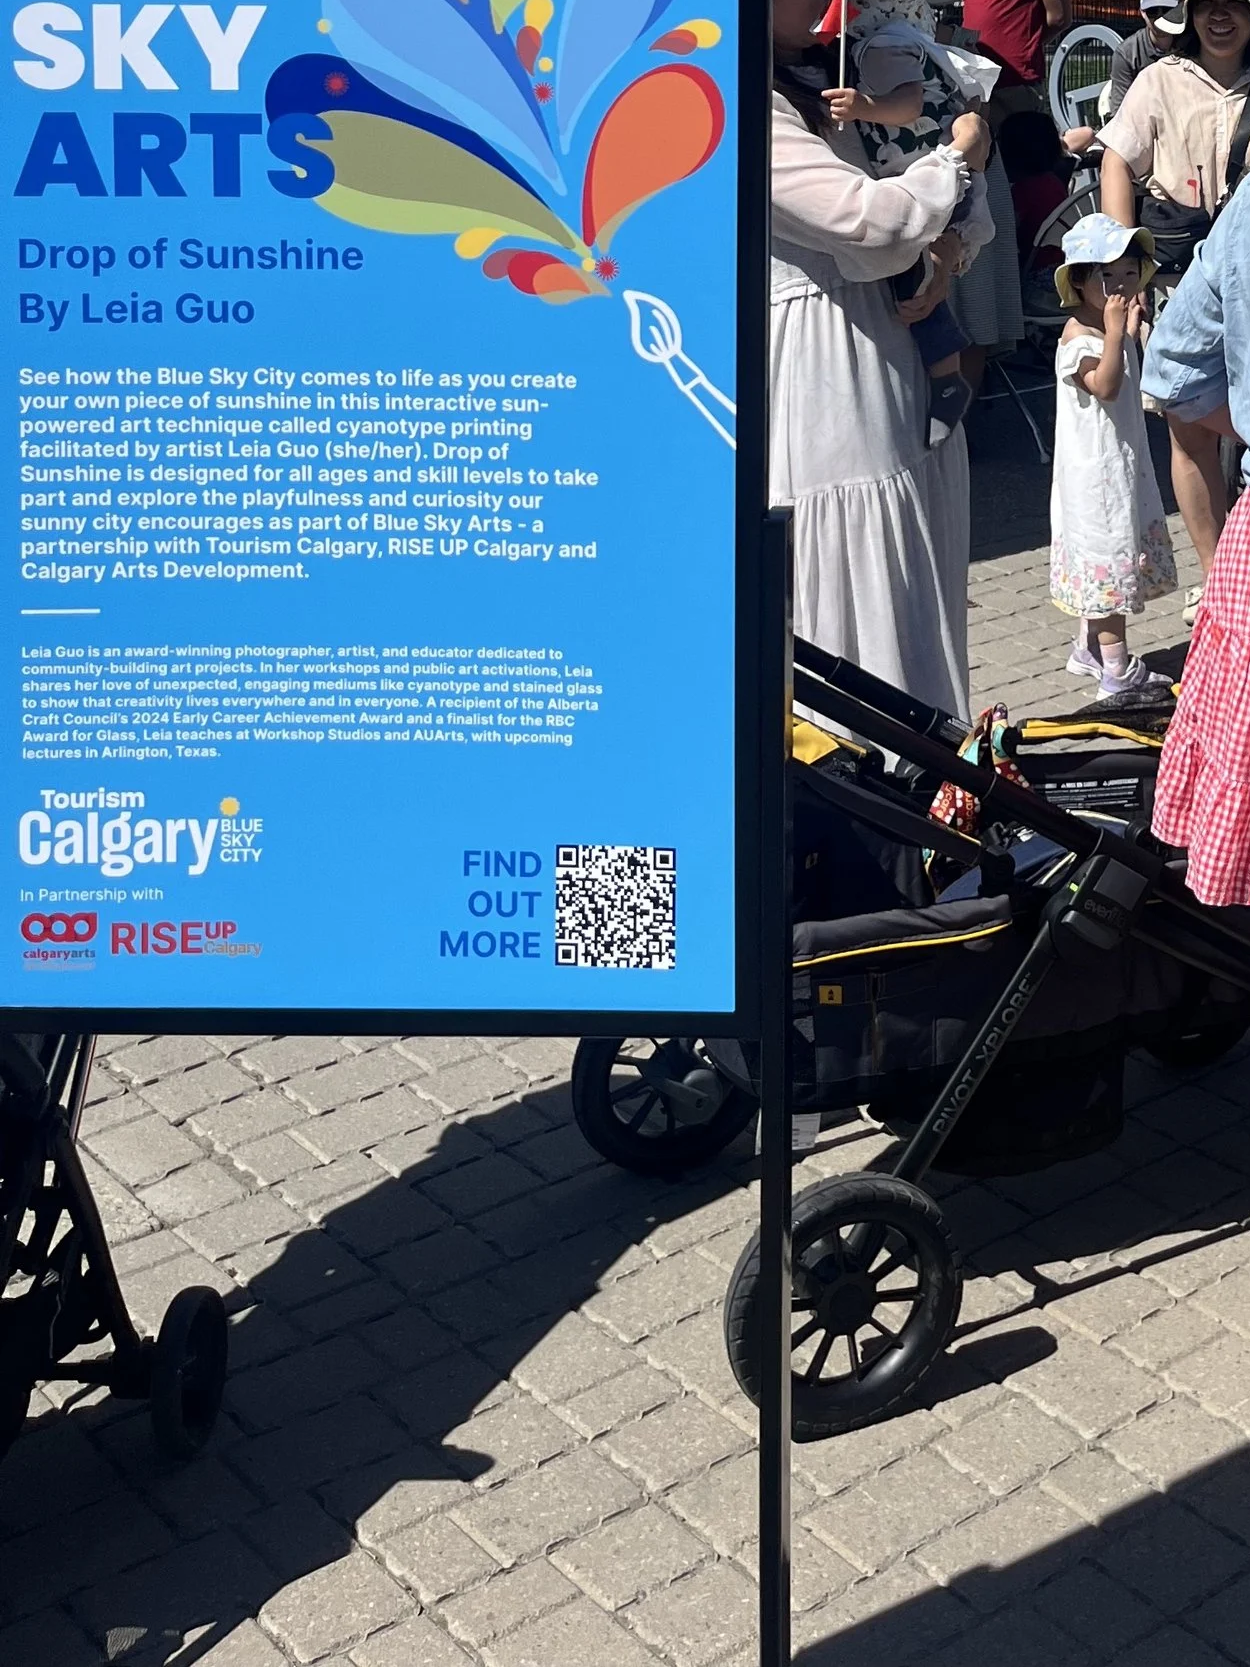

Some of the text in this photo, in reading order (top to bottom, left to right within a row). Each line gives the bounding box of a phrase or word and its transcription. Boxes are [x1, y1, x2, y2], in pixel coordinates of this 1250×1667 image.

[12, 2, 267, 91] SKY
[13, 112, 336, 199] ARTS
[18, 238, 365, 277] Drop of Sunshine
[18, 292, 255, 331] By Leia Guo
[20, 367, 576, 392] See how the Blue Sky City comes to life as you create
[20, 391, 548, 414] your own piece of sunshine in this interactive sun-
[20, 416, 532, 440] powered art technique called cyanotype printing
[20, 440, 509, 464] facilitated by artist Leia Guo (she/her). Drop of
[20, 464, 598, 486] Sunshine is designed for all ages and skill levels to take
[21, 488, 543, 512] part and explore the playfulness and curiosity our
[21, 513, 544, 536] sunny city encourages as part of Blue Sky Arts a
[21, 536, 596, 561] partnership with Tourism Calgary, RISE UP Calgary and
[22, 561, 309, 583] Calgary Arts Development.
[22, 646, 51, 658] Leia
[55, 646, 84, 658] Guo
[88, 646, 100, 657] is
[104, 648, 120, 657] an
[382, 646, 408, 657] and
[412, 646, 473, 658] educator
[477, 647, 545, 659] dedicated
[549, 649, 563, 660] to
[171, 662, 192, 673] art
[260, 662, 273, 673] In
[276, 662, 300, 673] her
[303, 662, 380, 676] workshops
[384, 662, 409, 674] and
[413, 662, 455, 676] public
[458, 664, 478, 674] art
[565, 666, 592, 677] Leia
[22, 714, 59, 725] Craft
[132, 712, 169, 724] 2024
[173, 712, 208, 726] Early
[212, 712, 260, 723] Career
[264, 712, 355, 723] Achievement
[359, 712, 403, 724] Award
[406, 713, 432, 724] and
[436, 715, 444, 724] a
[447, 713, 494, 725] finalist
[497, 714, 517, 725] for
[520, 715, 542, 726] the
[546, 715, 574, 727] RBC
[23, 730, 68, 742] Award
[72, 730, 93, 741] for
[144, 729, 172, 740] Leia
[176, 729, 232, 740] teaches
[236, 729, 249, 740] at
[253, 728, 324, 742] Workshop
[328, 728, 380, 740] Studios
[384, 730, 410, 740] and
[472, 730, 501, 742] with
[504, 732, 572, 746] upcoming
[40, 789, 145, 809] Tourism
[220, 818, 264, 833] BLUE
[19, 811, 220, 877] Calgary
[220, 833, 255, 848] SKY
[220, 848, 263, 863] CITY
[462, 850, 542, 878] FIND
[20, 888, 163, 903] In Partnership with
[468, 890, 542, 918] OUT
[111, 921, 237, 954] RISE UP
[439, 931, 542, 959] MORE
[23, 948, 96, 961] calgaryarts
[203, 941, 262, 958] Calgary
[932, 1068, 978, 1135] PIVOT
